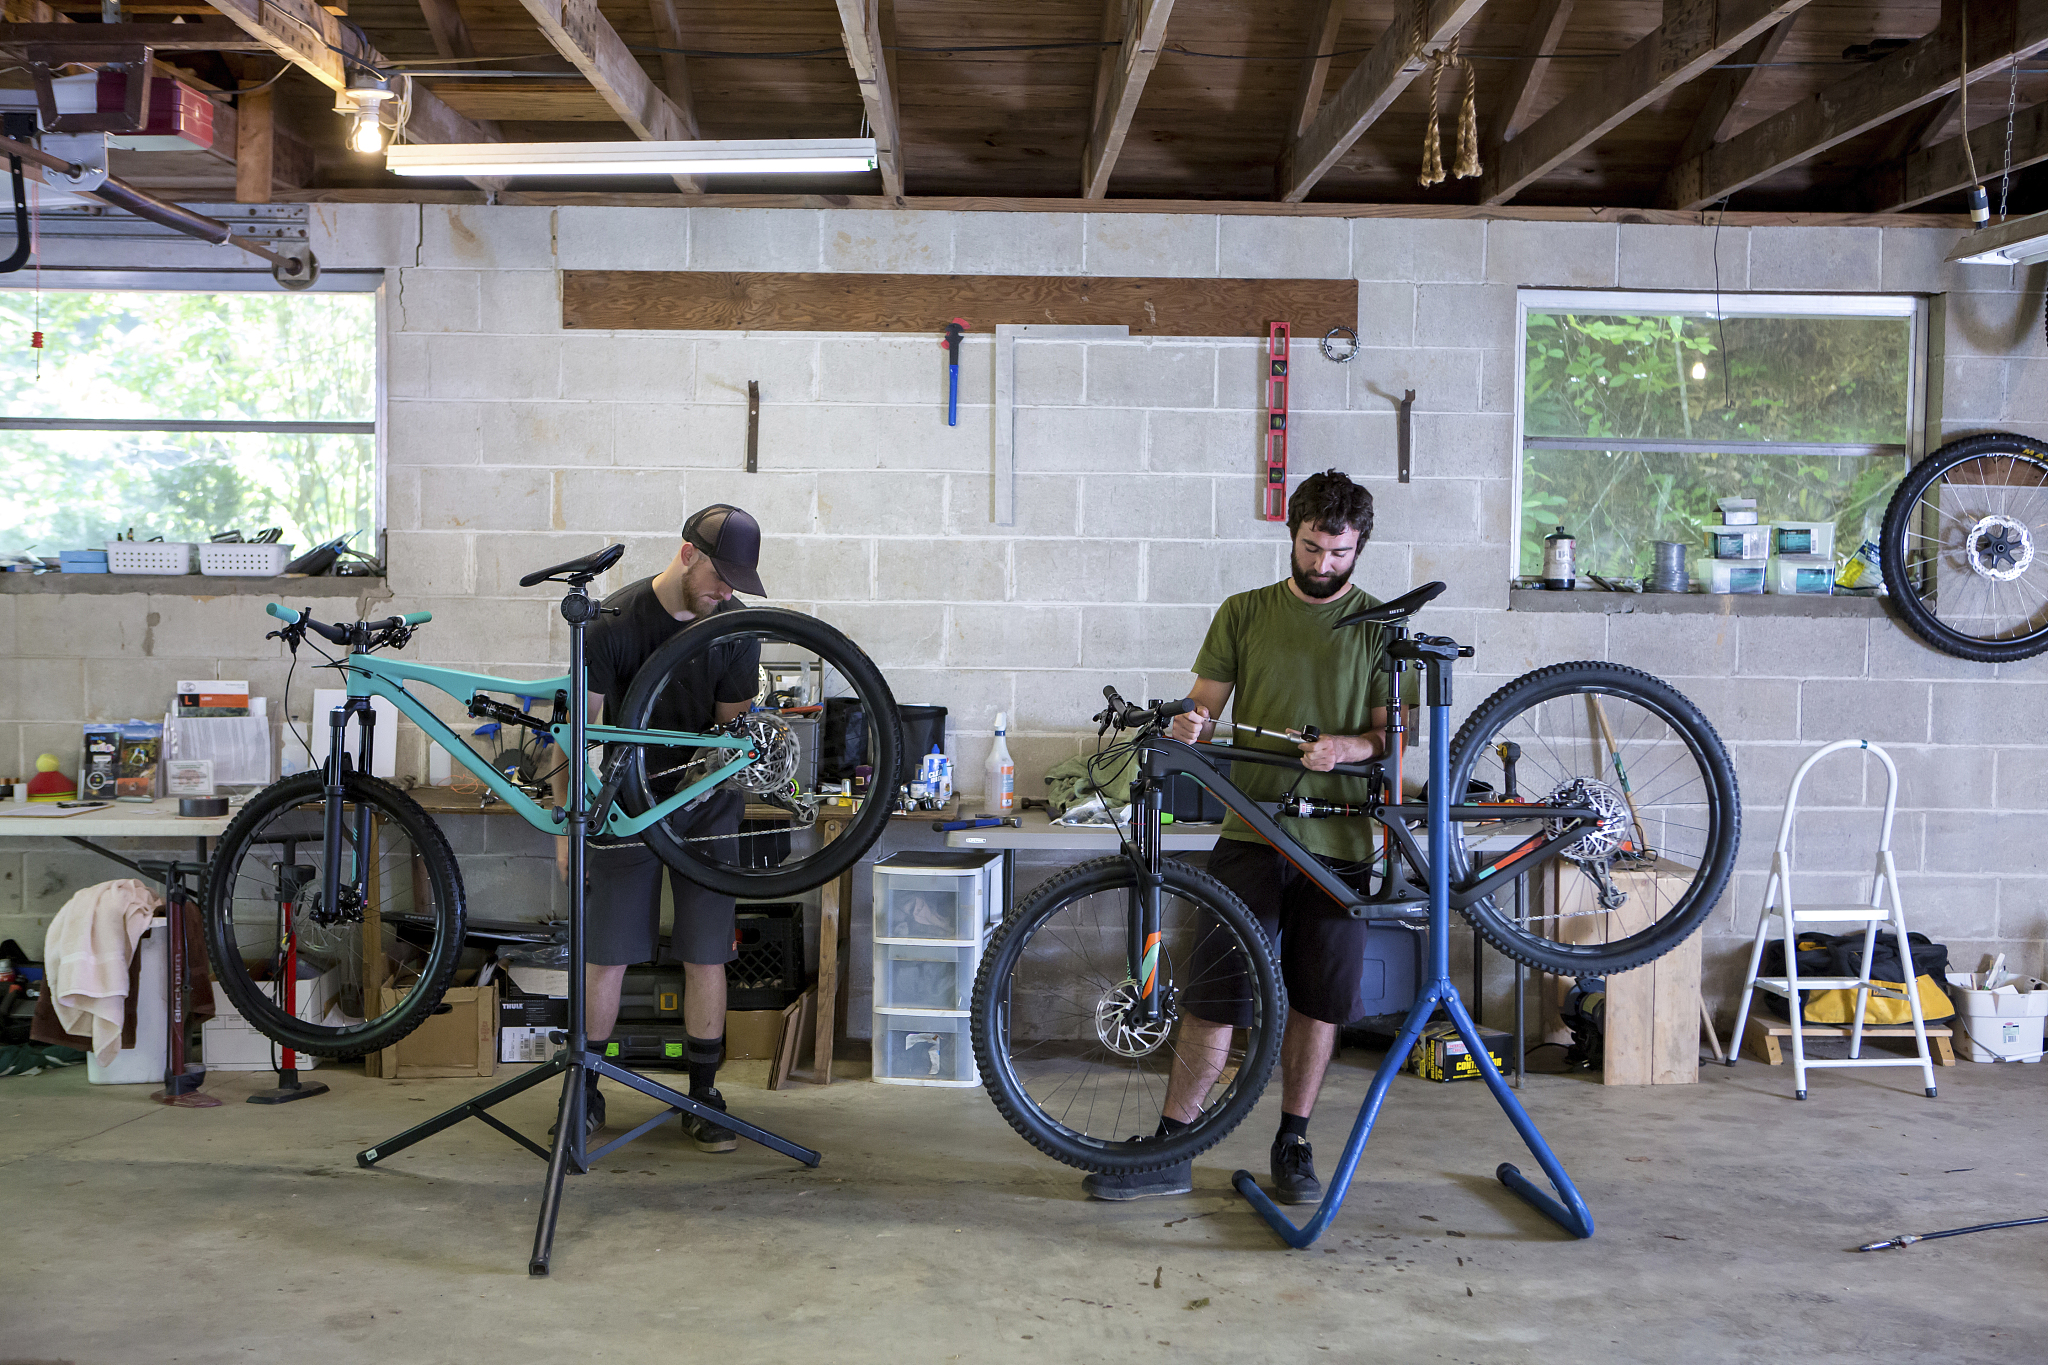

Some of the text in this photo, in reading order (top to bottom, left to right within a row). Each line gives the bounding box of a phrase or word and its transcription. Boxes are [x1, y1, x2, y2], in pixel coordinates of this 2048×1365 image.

[2022, 448, 2048, 462] MA
[174, 954, 182, 1023] Blackburn
[1456, 1057, 1502, 1071] CONTOR
